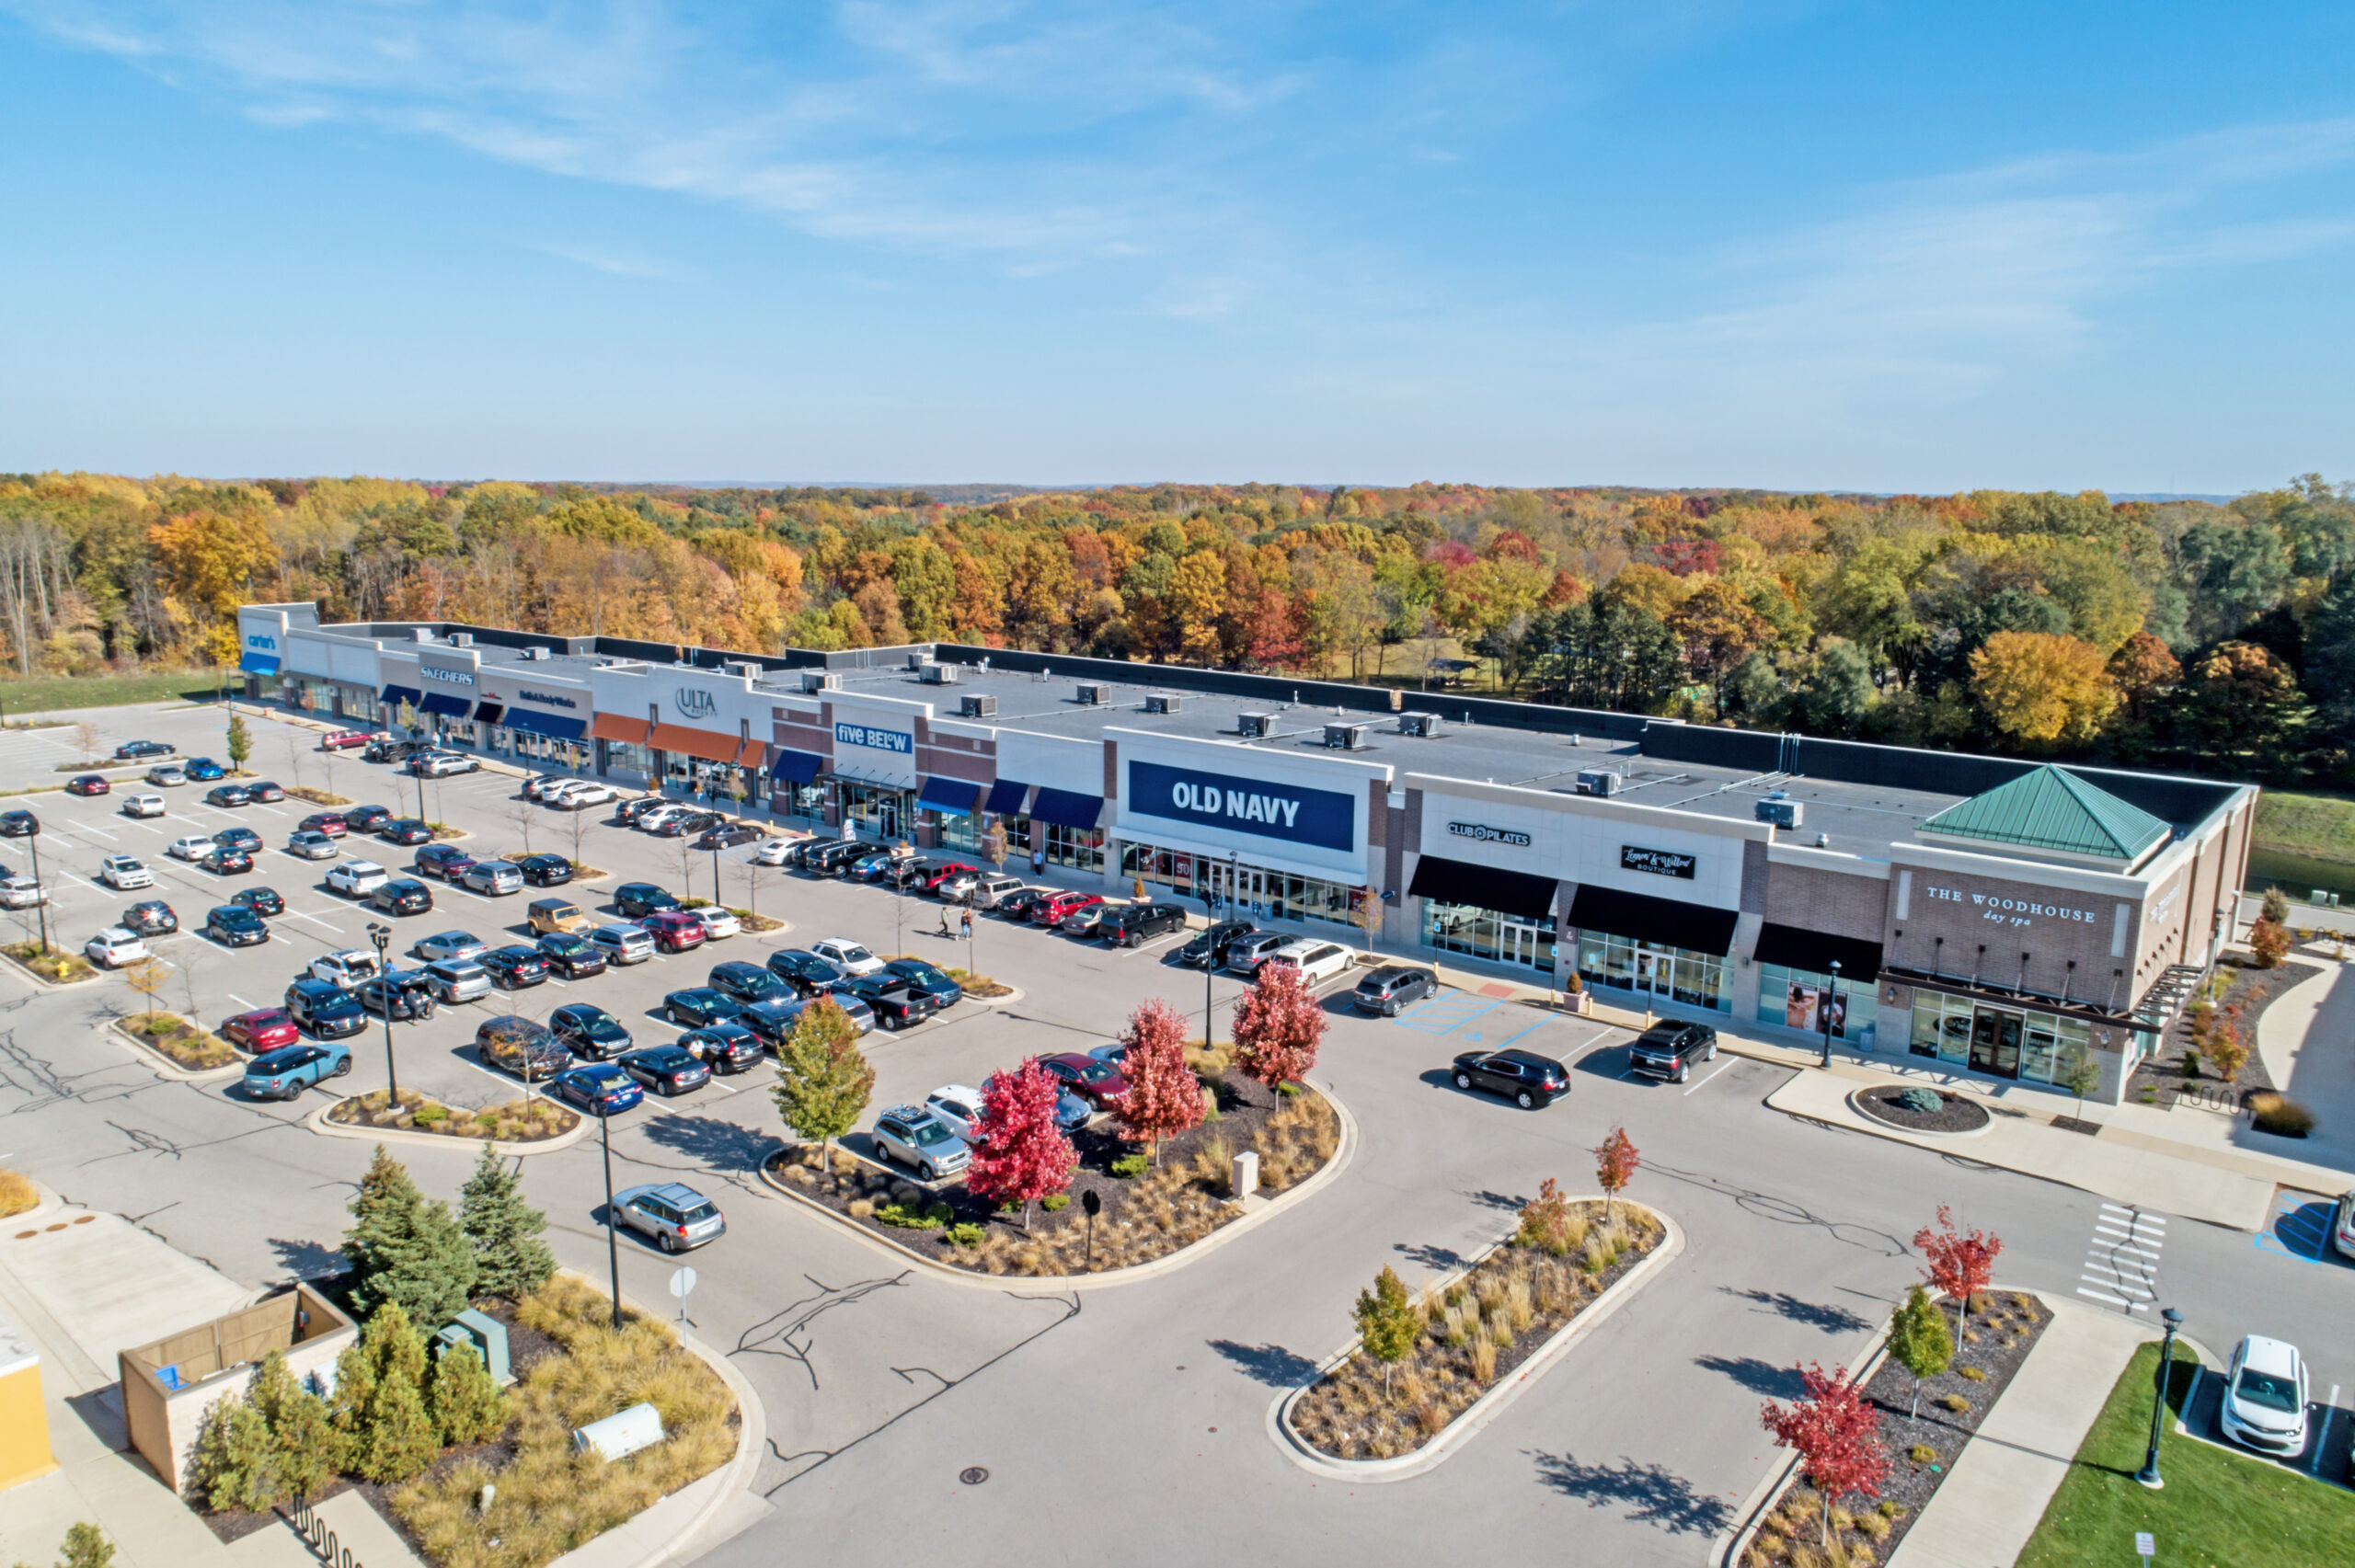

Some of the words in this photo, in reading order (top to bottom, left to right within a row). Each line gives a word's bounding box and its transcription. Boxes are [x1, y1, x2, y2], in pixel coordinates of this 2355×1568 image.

[420, 667, 474, 685] SKECHERS
[681, 688, 716, 712] ULTA
[1172, 782, 1223, 813] OLD
[1226, 790, 1300, 828] NAVY
[1448, 824, 1474, 837] CLUB
[1487, 830, 1529, 845] PILATES
[1637, 864, 1676, 875] BOUTIQUE
[1927, 887, 1962, 902] THE
[1972, 893, 2095, 923] WOODHOUSE
[1983, 910, 2005, 923] day
[2009, 917, 2031, 927] spa
